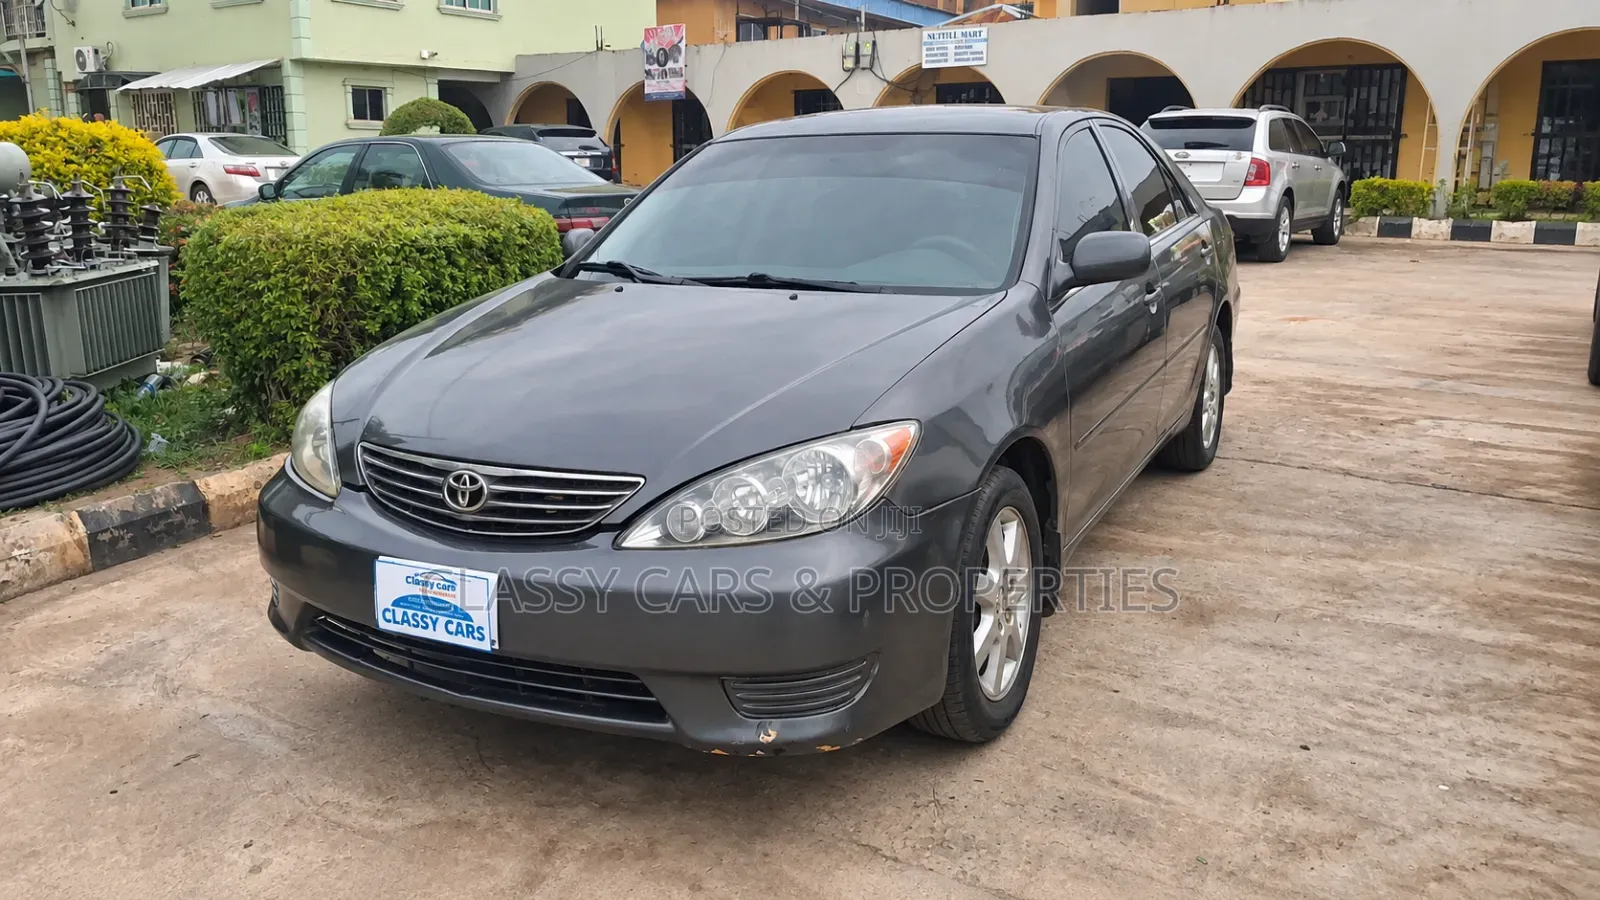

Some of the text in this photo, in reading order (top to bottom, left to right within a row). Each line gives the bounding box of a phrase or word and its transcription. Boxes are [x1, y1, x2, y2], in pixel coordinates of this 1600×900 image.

[961, 30, 983, 38] MART
[405, 575, 435, 590] Classy
[381, 607, 439, 632] CLASSY
[444, 619, 486, 642] CARS
